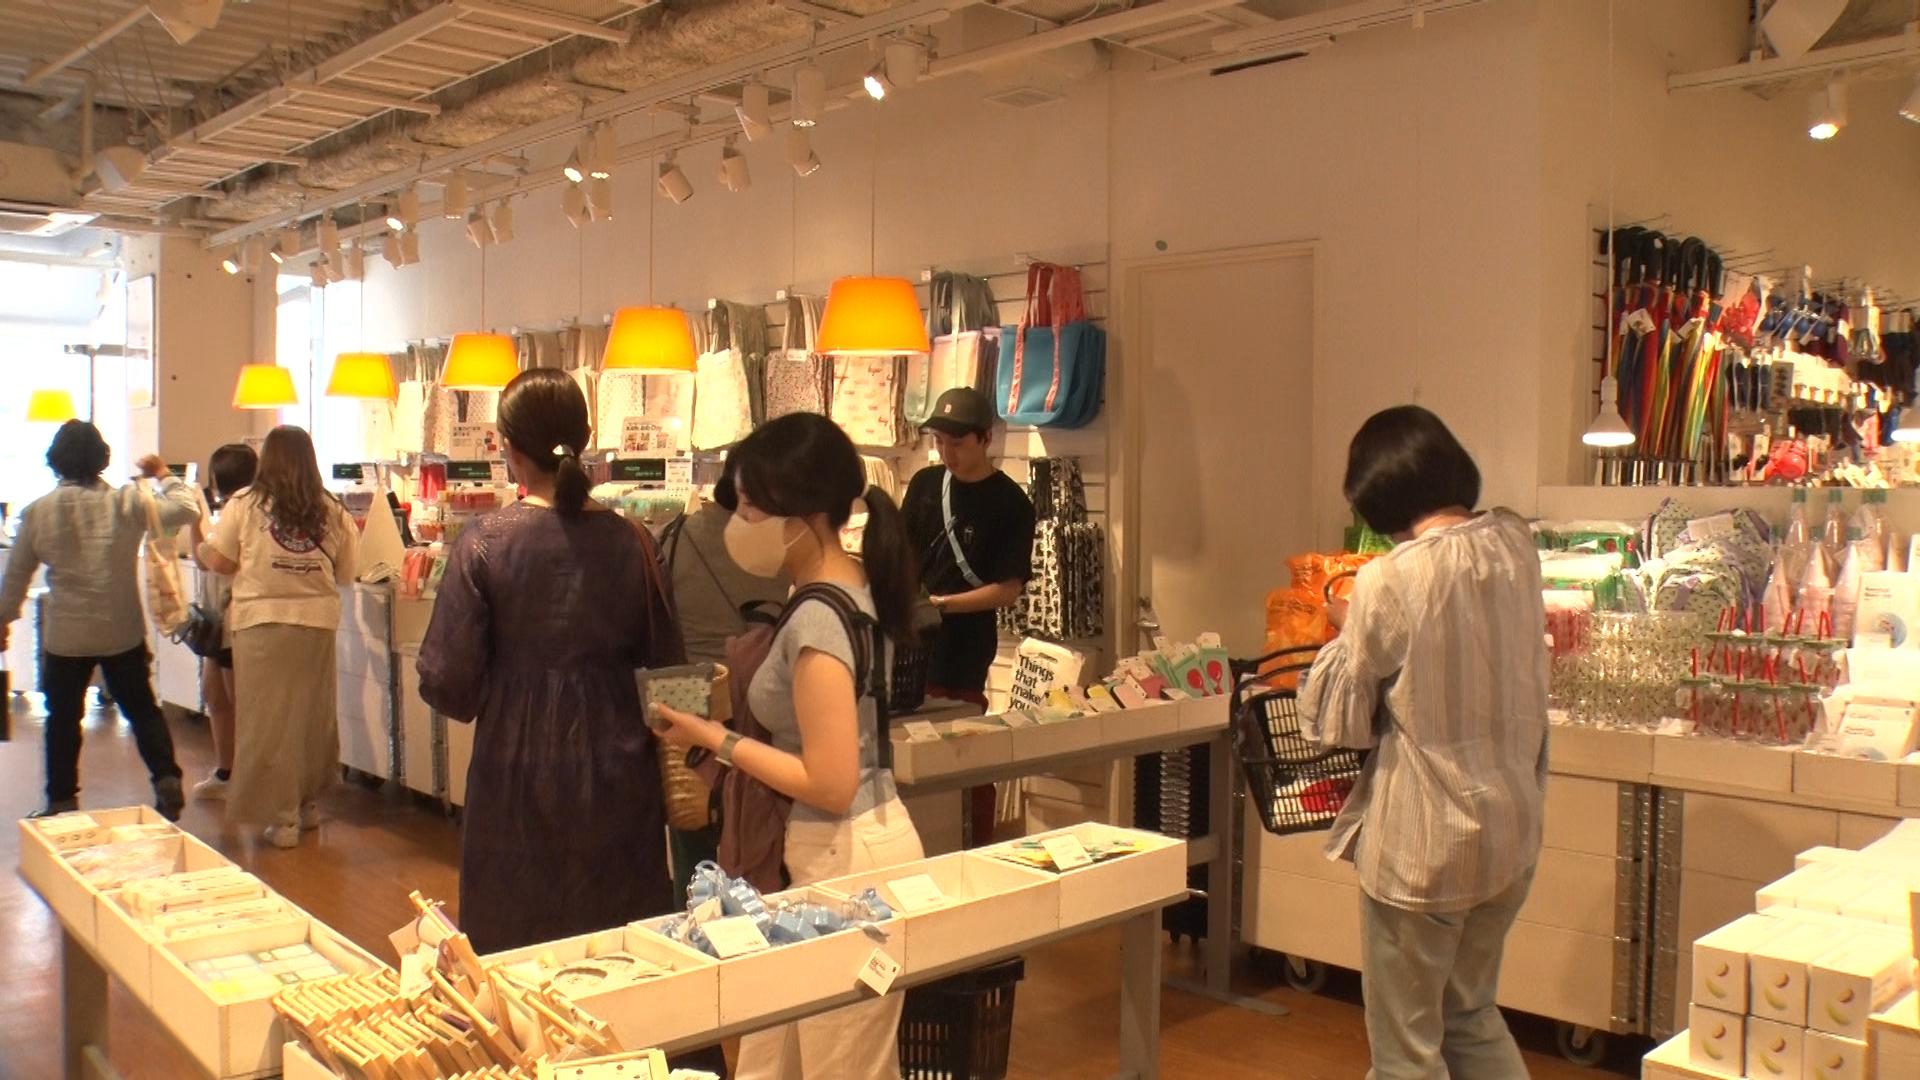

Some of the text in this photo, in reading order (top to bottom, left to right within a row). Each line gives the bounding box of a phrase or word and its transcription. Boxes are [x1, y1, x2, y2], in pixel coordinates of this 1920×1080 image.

[1019, 655, 1054, 682] Things
[1015, 669, 1037, 689] that
[1011, 684, 1041, 704] make
